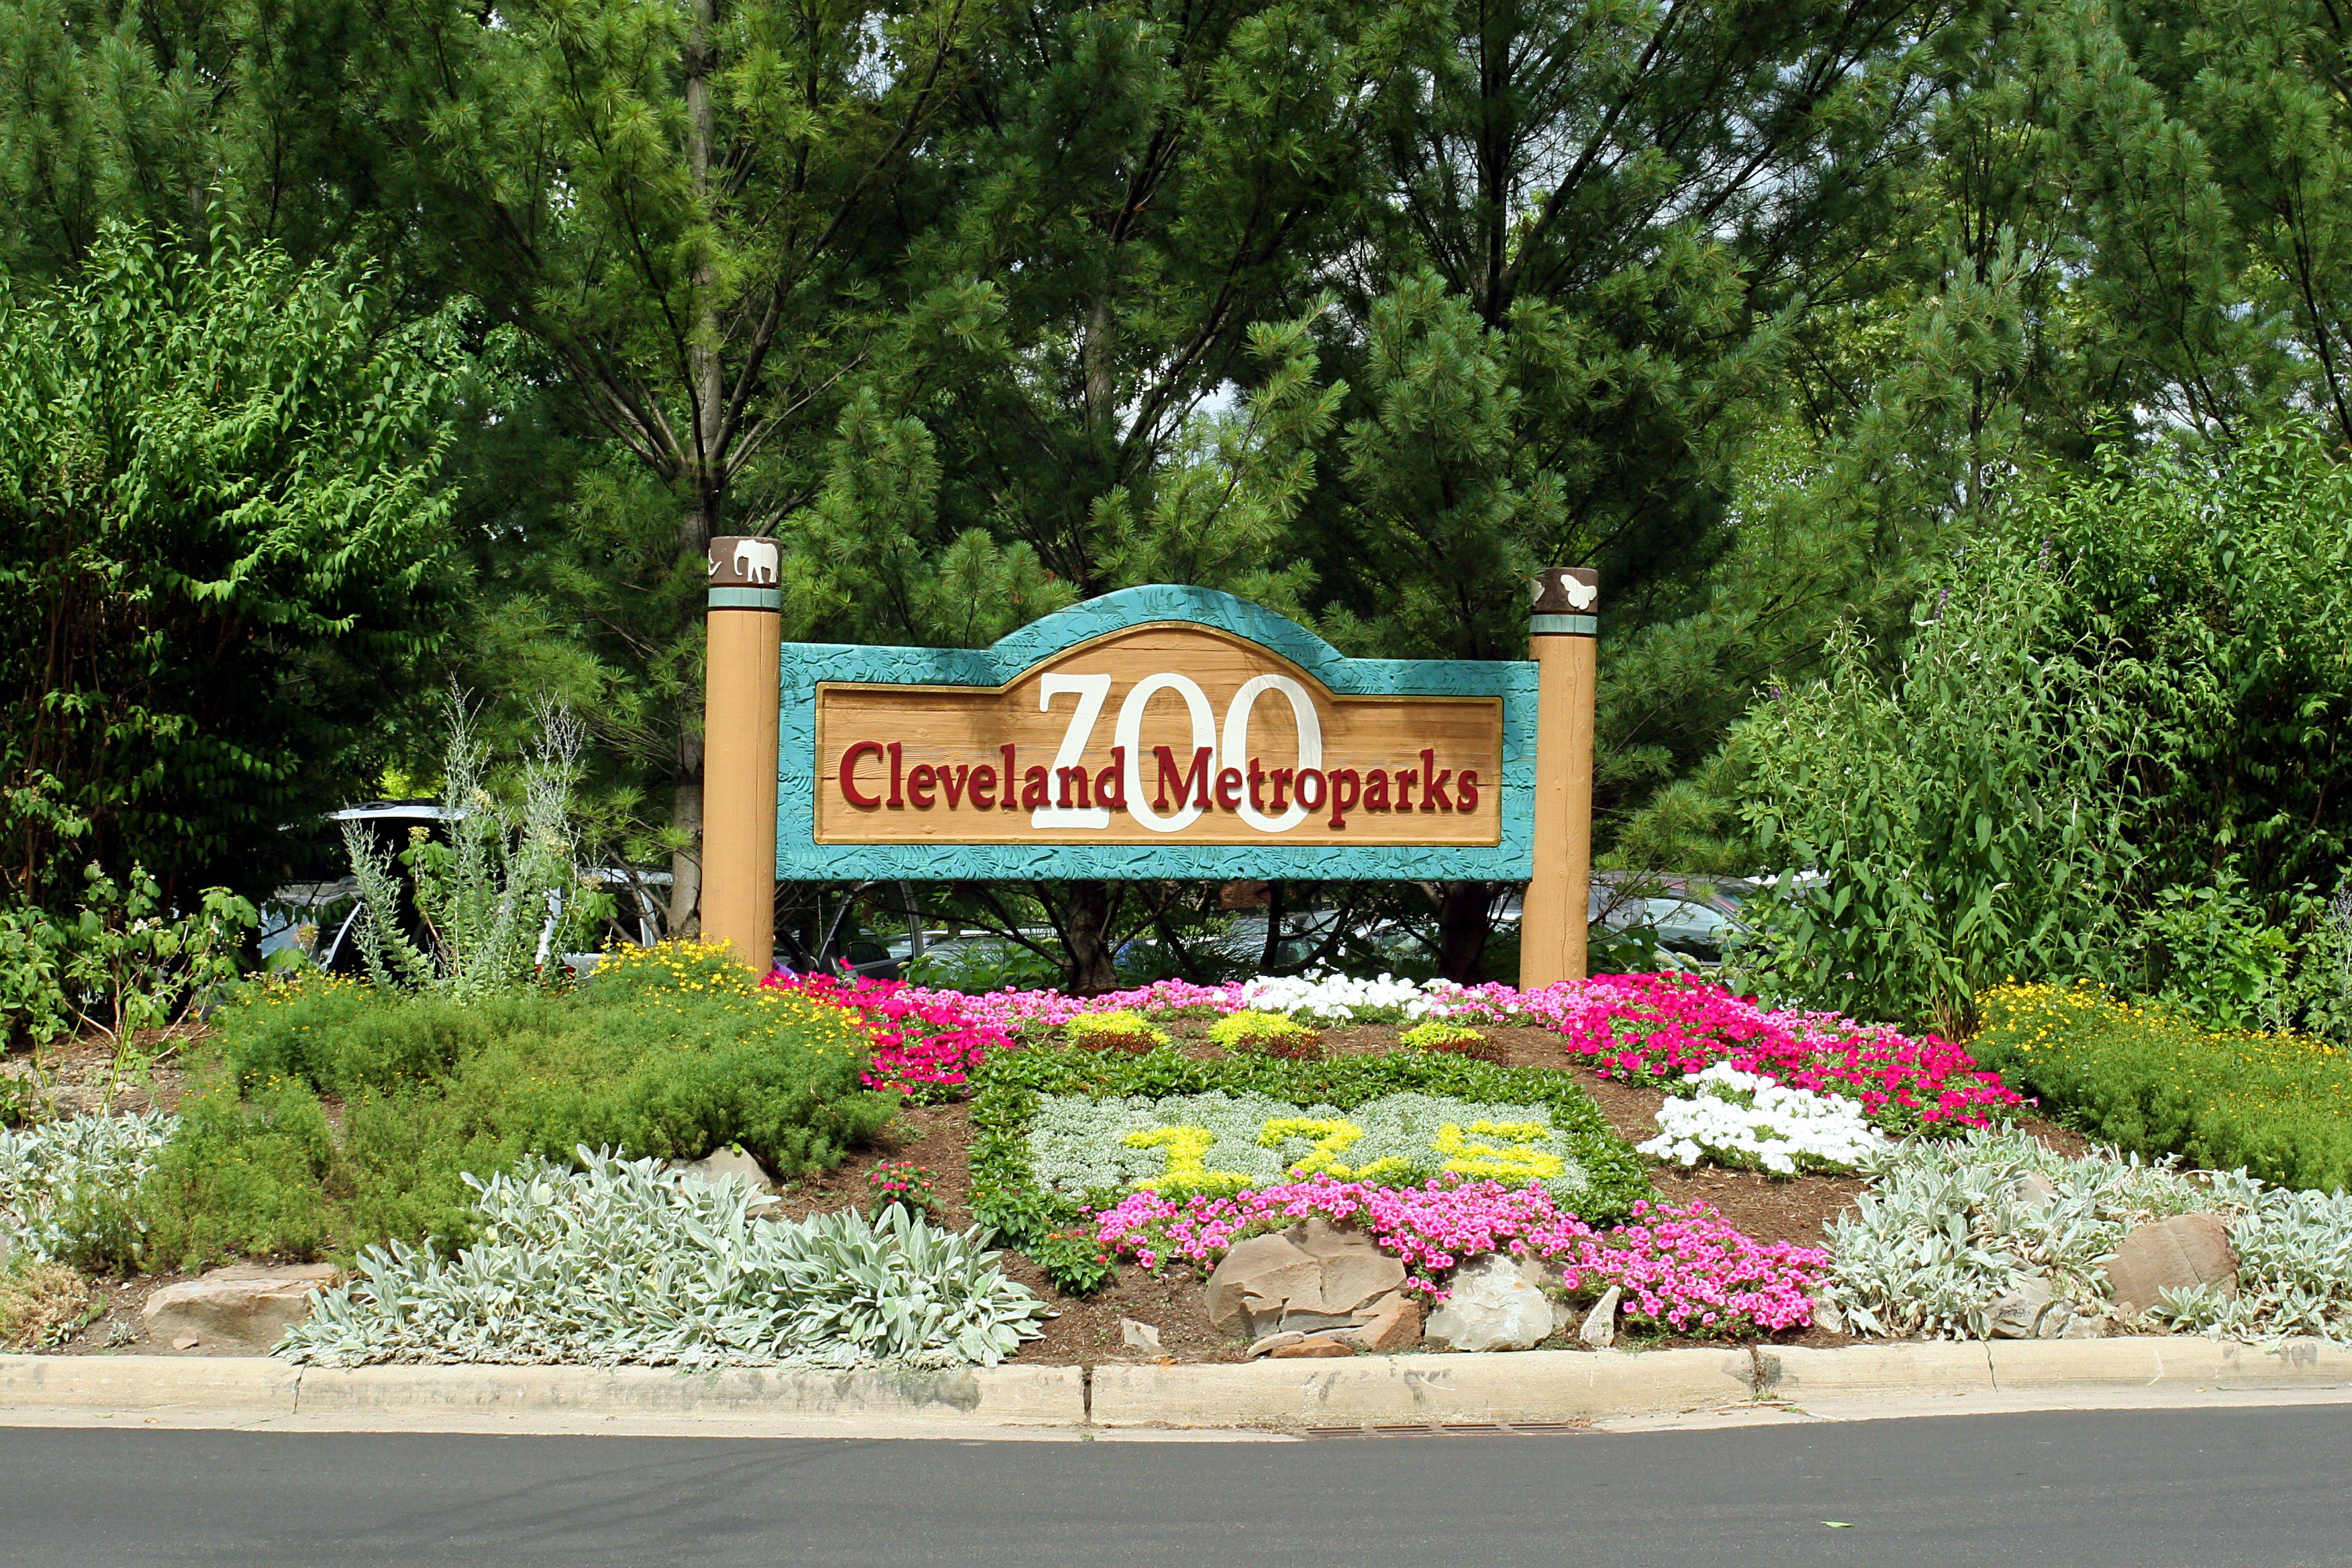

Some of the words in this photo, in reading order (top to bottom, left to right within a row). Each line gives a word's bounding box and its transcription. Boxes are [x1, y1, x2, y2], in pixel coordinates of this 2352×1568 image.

[839, 740, 1128, 810] Cleveland
[1153, 745, 1479, 828] Metroparks
[1031, 672, 1322, 832] ZOO
[1123, 1116, 1565, 1191] 125
